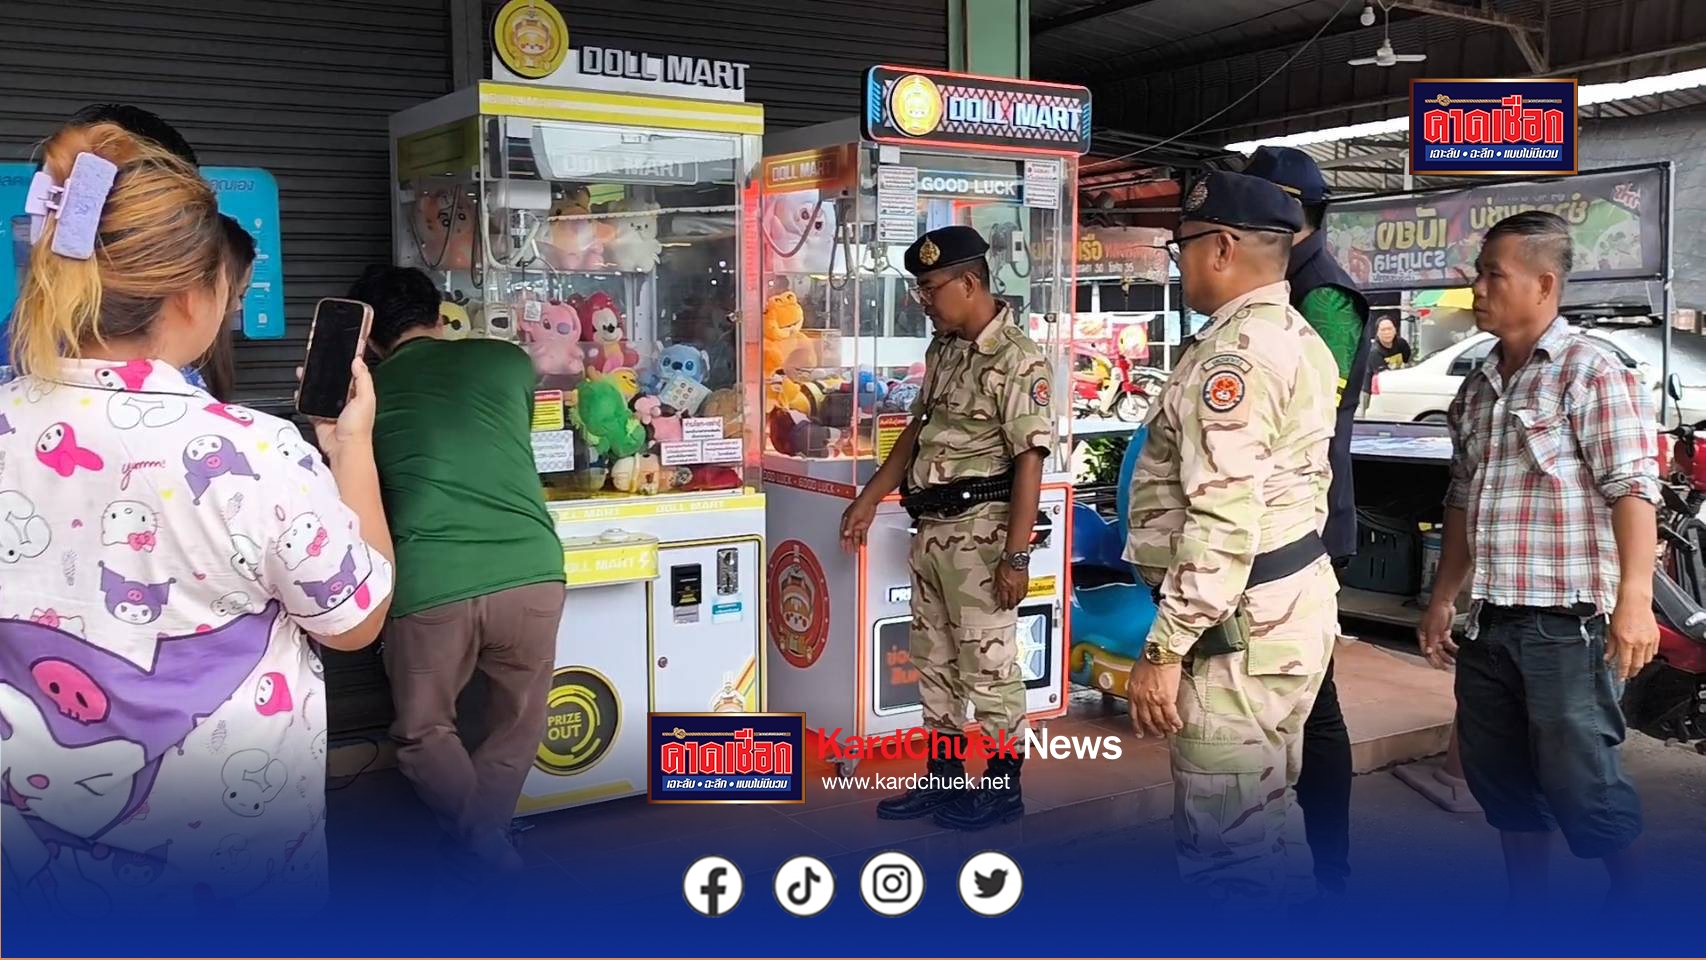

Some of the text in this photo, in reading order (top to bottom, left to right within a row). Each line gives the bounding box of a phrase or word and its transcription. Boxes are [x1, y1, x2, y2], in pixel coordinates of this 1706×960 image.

[580, 46, 750, 90] DOLL MART
[947, 95, 1083, 133] DOLL MART
[772, 159, 832, 183] DOLL MART
[921, 176, 1017, 196] GOOD LUCK
[547, 711, 582, 727] PRIZE
[547, 723, 582, 741] OUT
